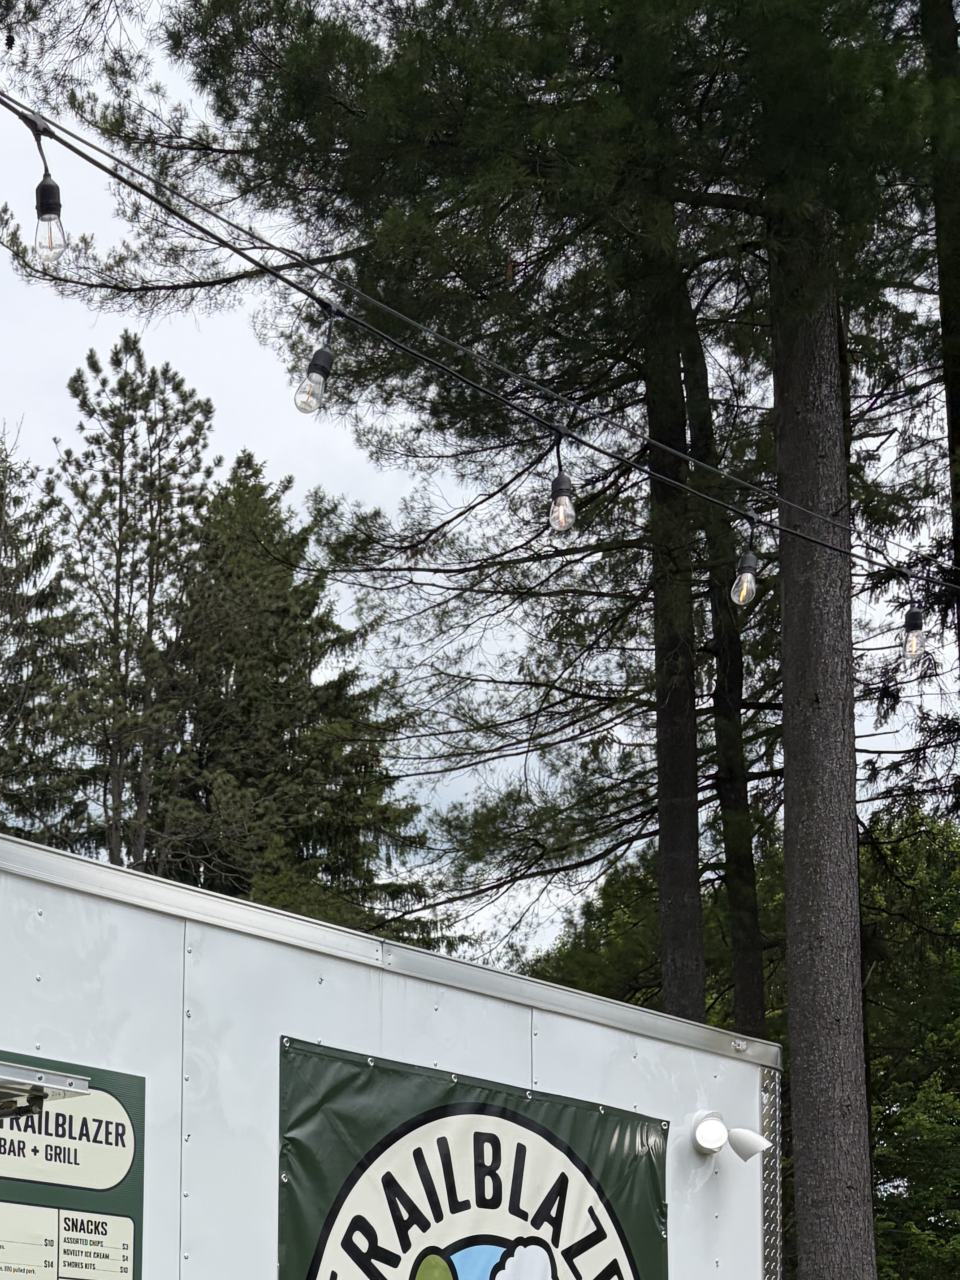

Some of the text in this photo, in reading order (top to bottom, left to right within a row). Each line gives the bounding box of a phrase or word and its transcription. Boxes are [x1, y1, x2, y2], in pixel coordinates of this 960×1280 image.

[44, 1143, 81, 1166] GRILL
[63, 1216, 108, 1236] SNACKS
[63, 1236, 88, 1245] ASSORTED
[89, 1239, 104, 1247] CHIPS
[43, 1260, 54, 1268] $14
